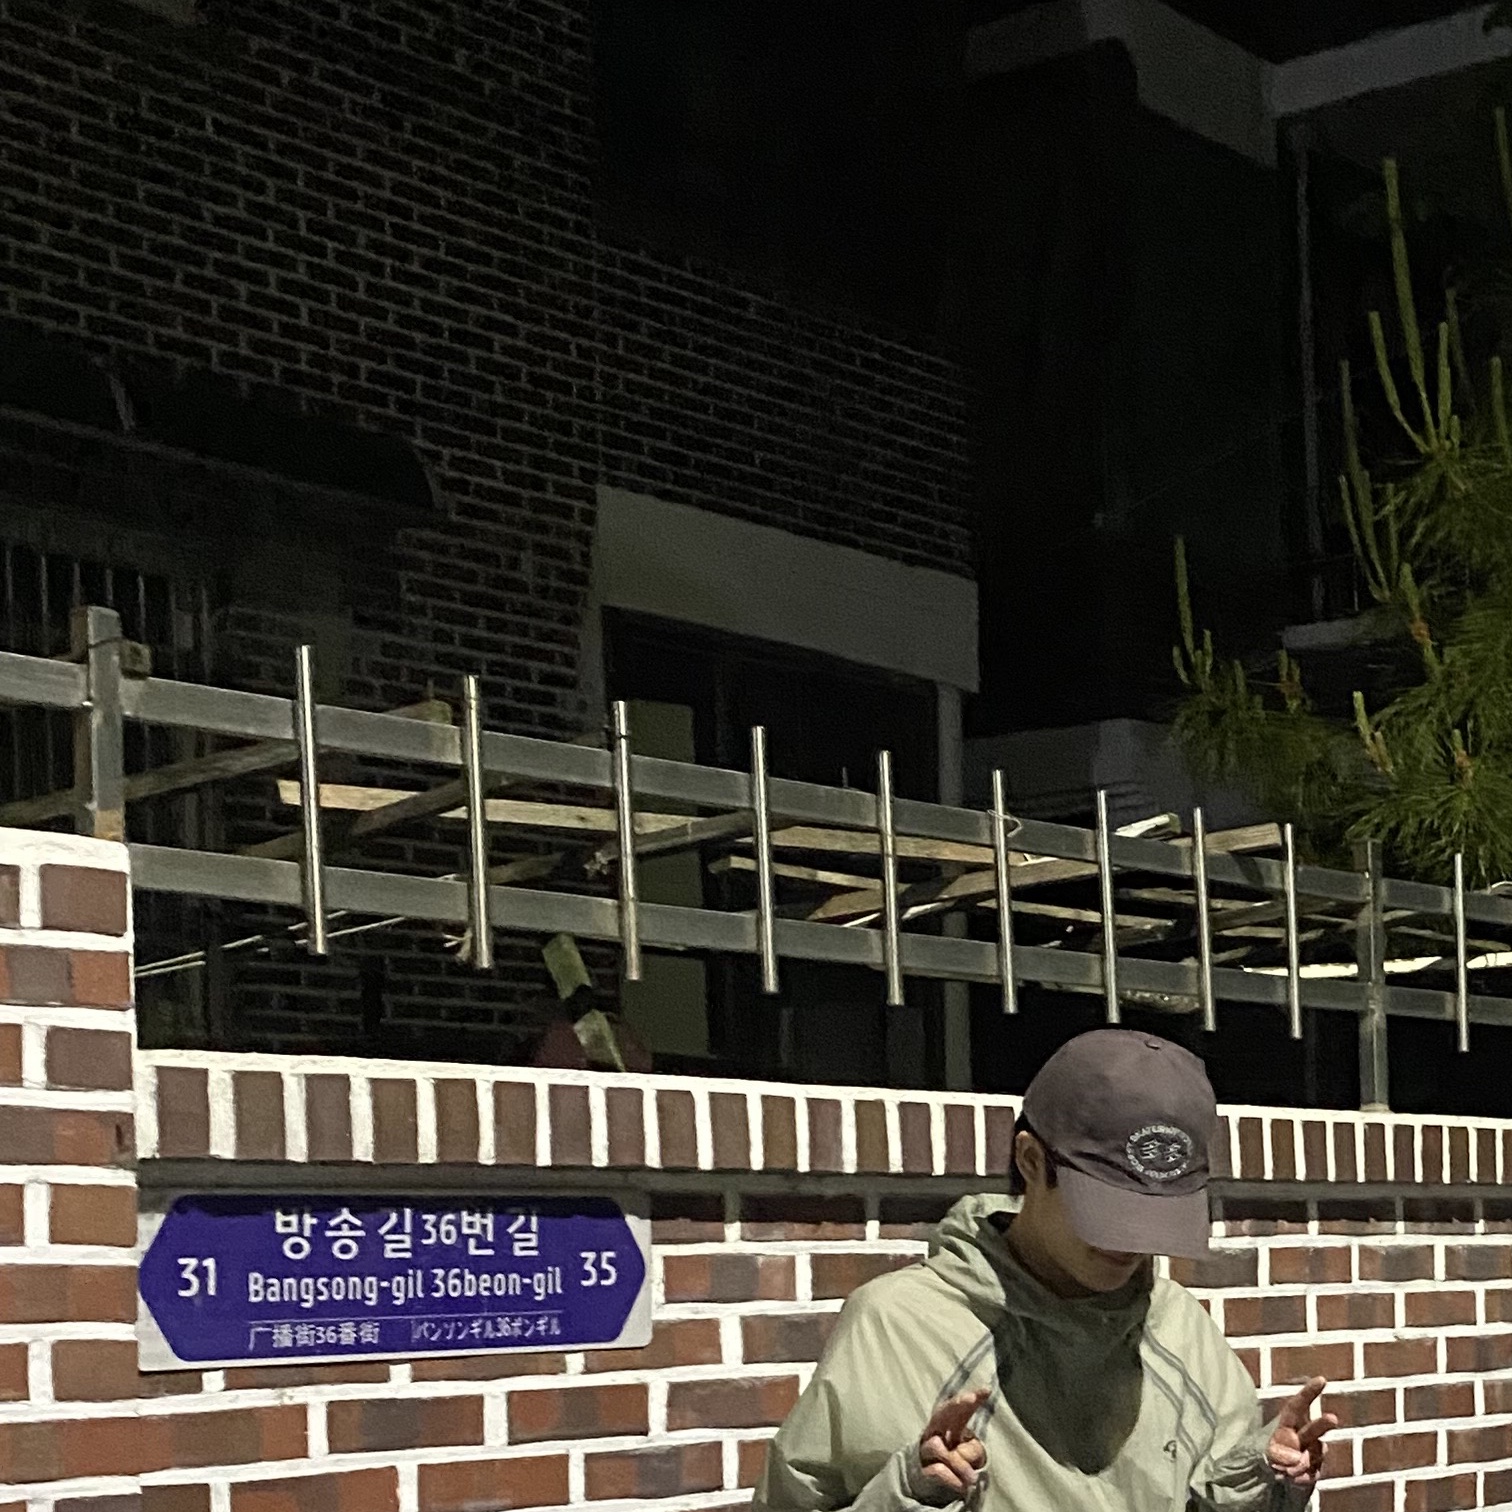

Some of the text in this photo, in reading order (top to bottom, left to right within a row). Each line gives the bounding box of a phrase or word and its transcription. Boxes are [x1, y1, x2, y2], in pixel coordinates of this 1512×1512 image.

[177, 1256, 218, 1297] 31
[247, 1266, 563, 1309] Bangsong-gil 36beon-gil
[579, 1250, 618, 1288] 35
